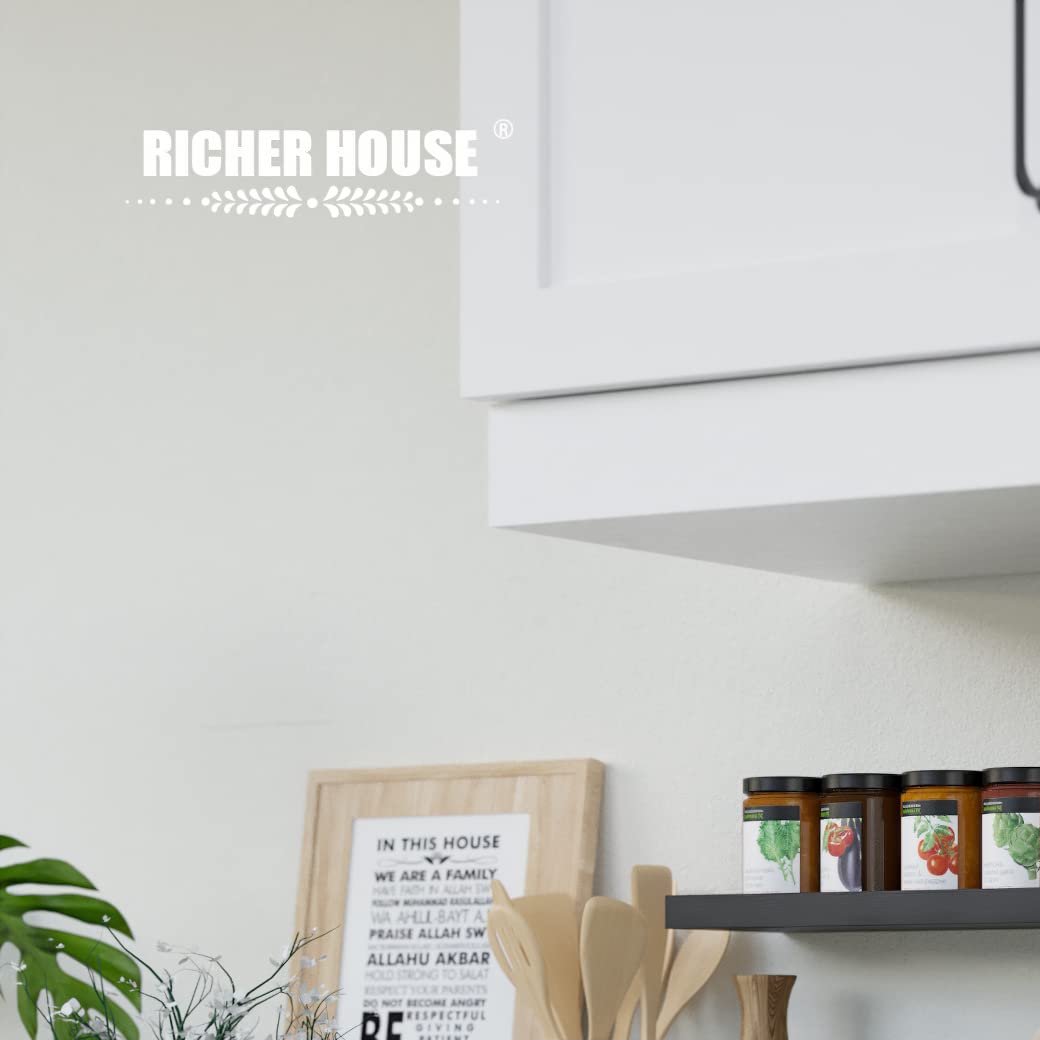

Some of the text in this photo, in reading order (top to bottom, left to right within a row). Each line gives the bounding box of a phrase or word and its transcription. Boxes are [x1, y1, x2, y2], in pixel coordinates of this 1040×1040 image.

[377, 835, 500, 851] IN THIS HOUSE
[374, 868, 498, 882] WE ARE A FAMILY
[369, 927, 488, 940] PRAISE ALLAH SW
[367, 951, 490, 966] ALLAHU AKBAR
[381, 998, 403, 1008] NOT
[406, 998, 447, 1008] BECOME
[406, 1011, 487, 1021] RESPECTFUL
[415, 1023, 475, 1033] GIVING
